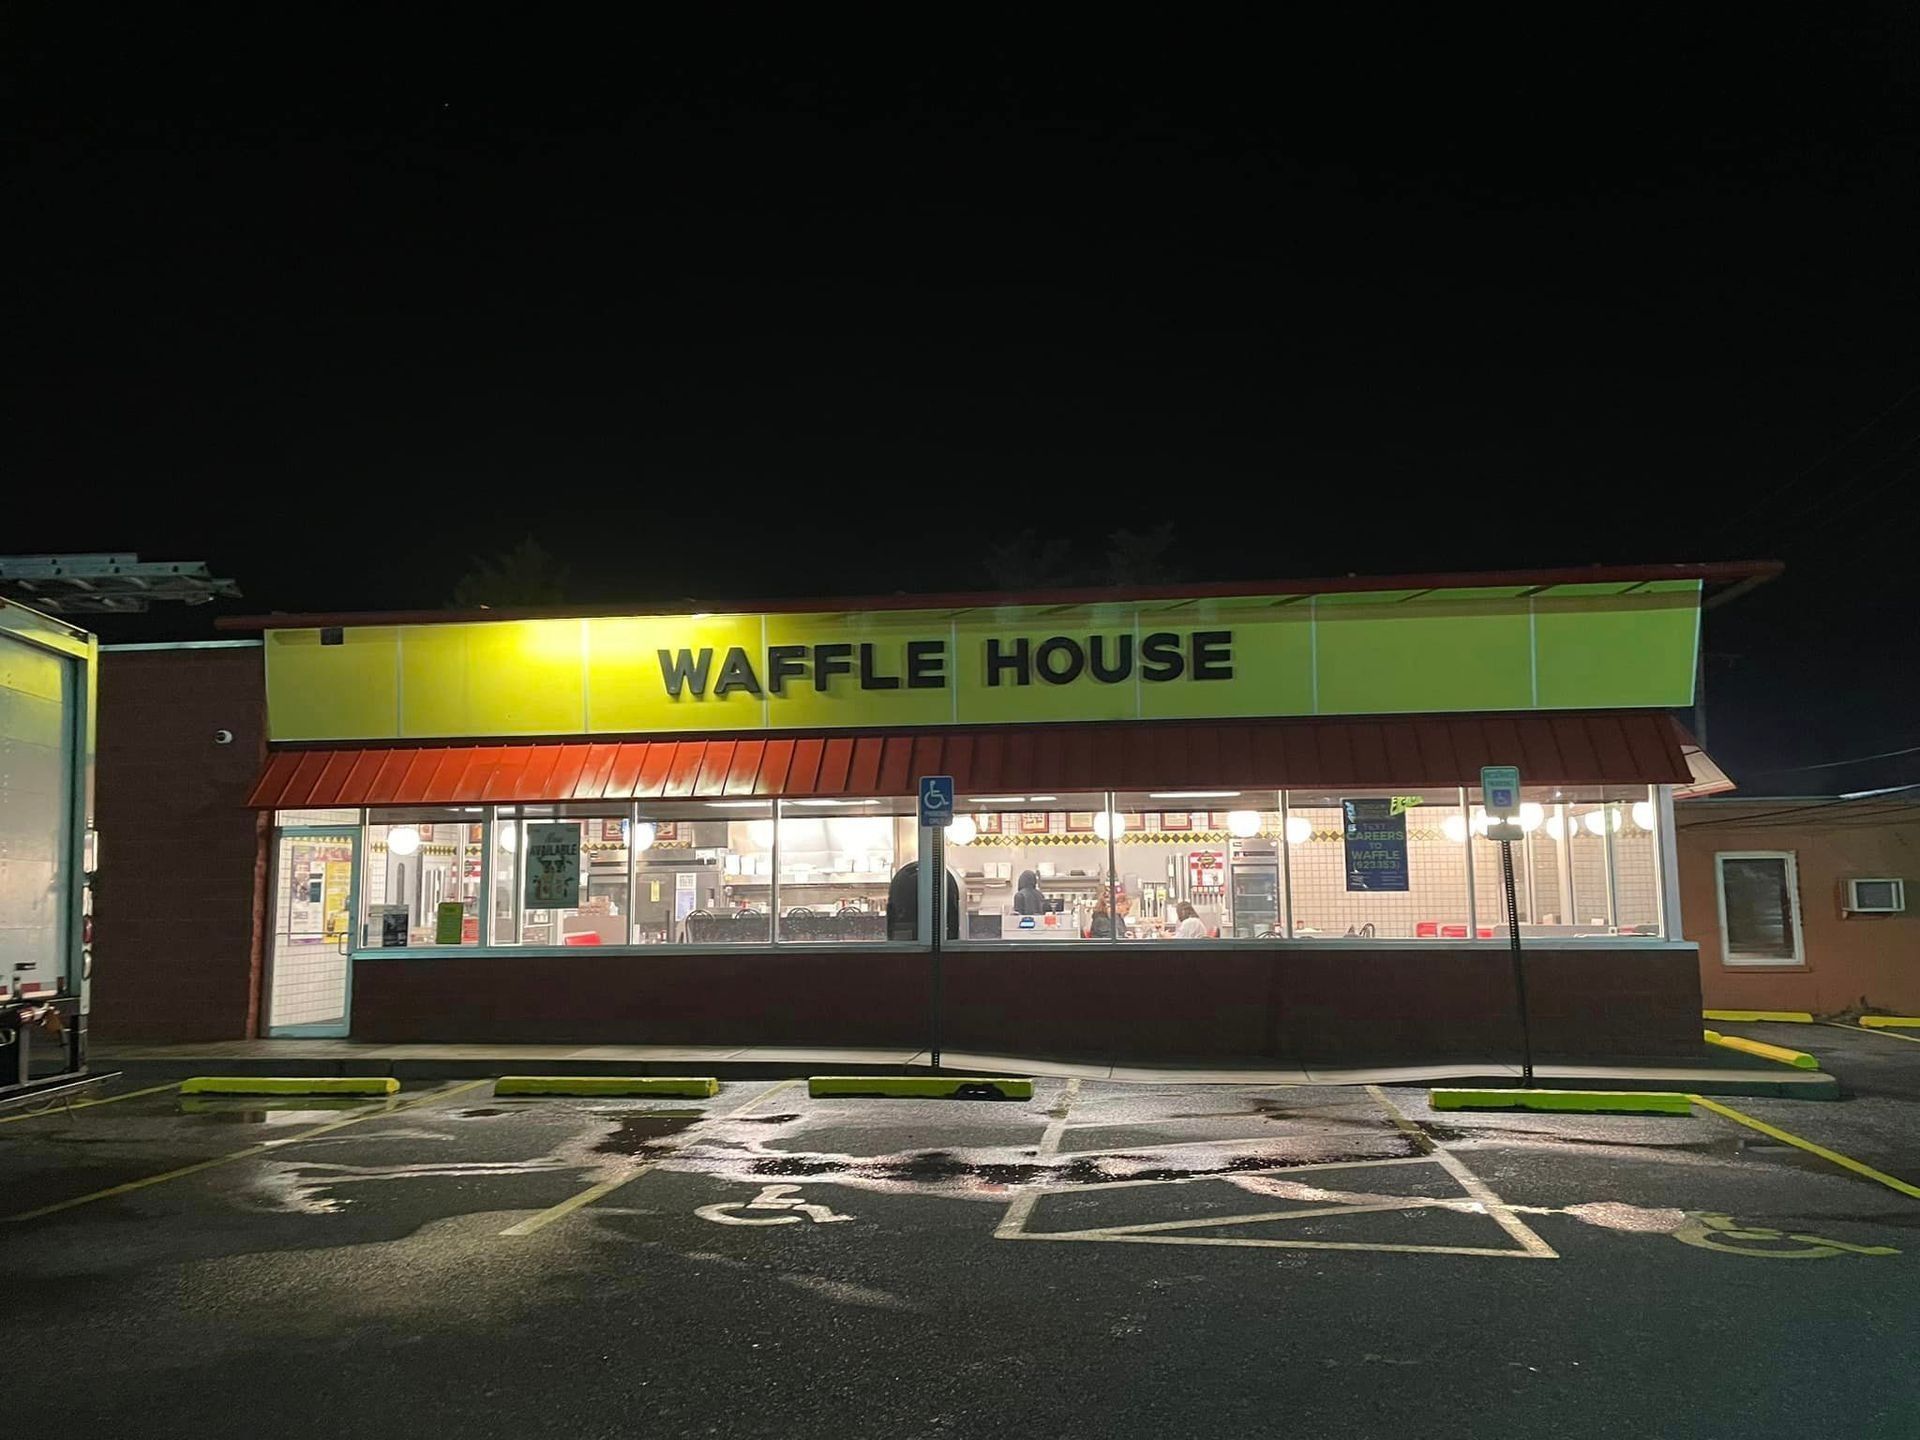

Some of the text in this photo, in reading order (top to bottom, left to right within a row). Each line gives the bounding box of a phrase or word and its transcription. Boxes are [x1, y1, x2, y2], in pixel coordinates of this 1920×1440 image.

[657, 631, 1233, 697] WAFFLE HOUSE
[1346, 831, 1404, 841] CAREERS
[1351, 850, 1401, 860] WAFFLE
